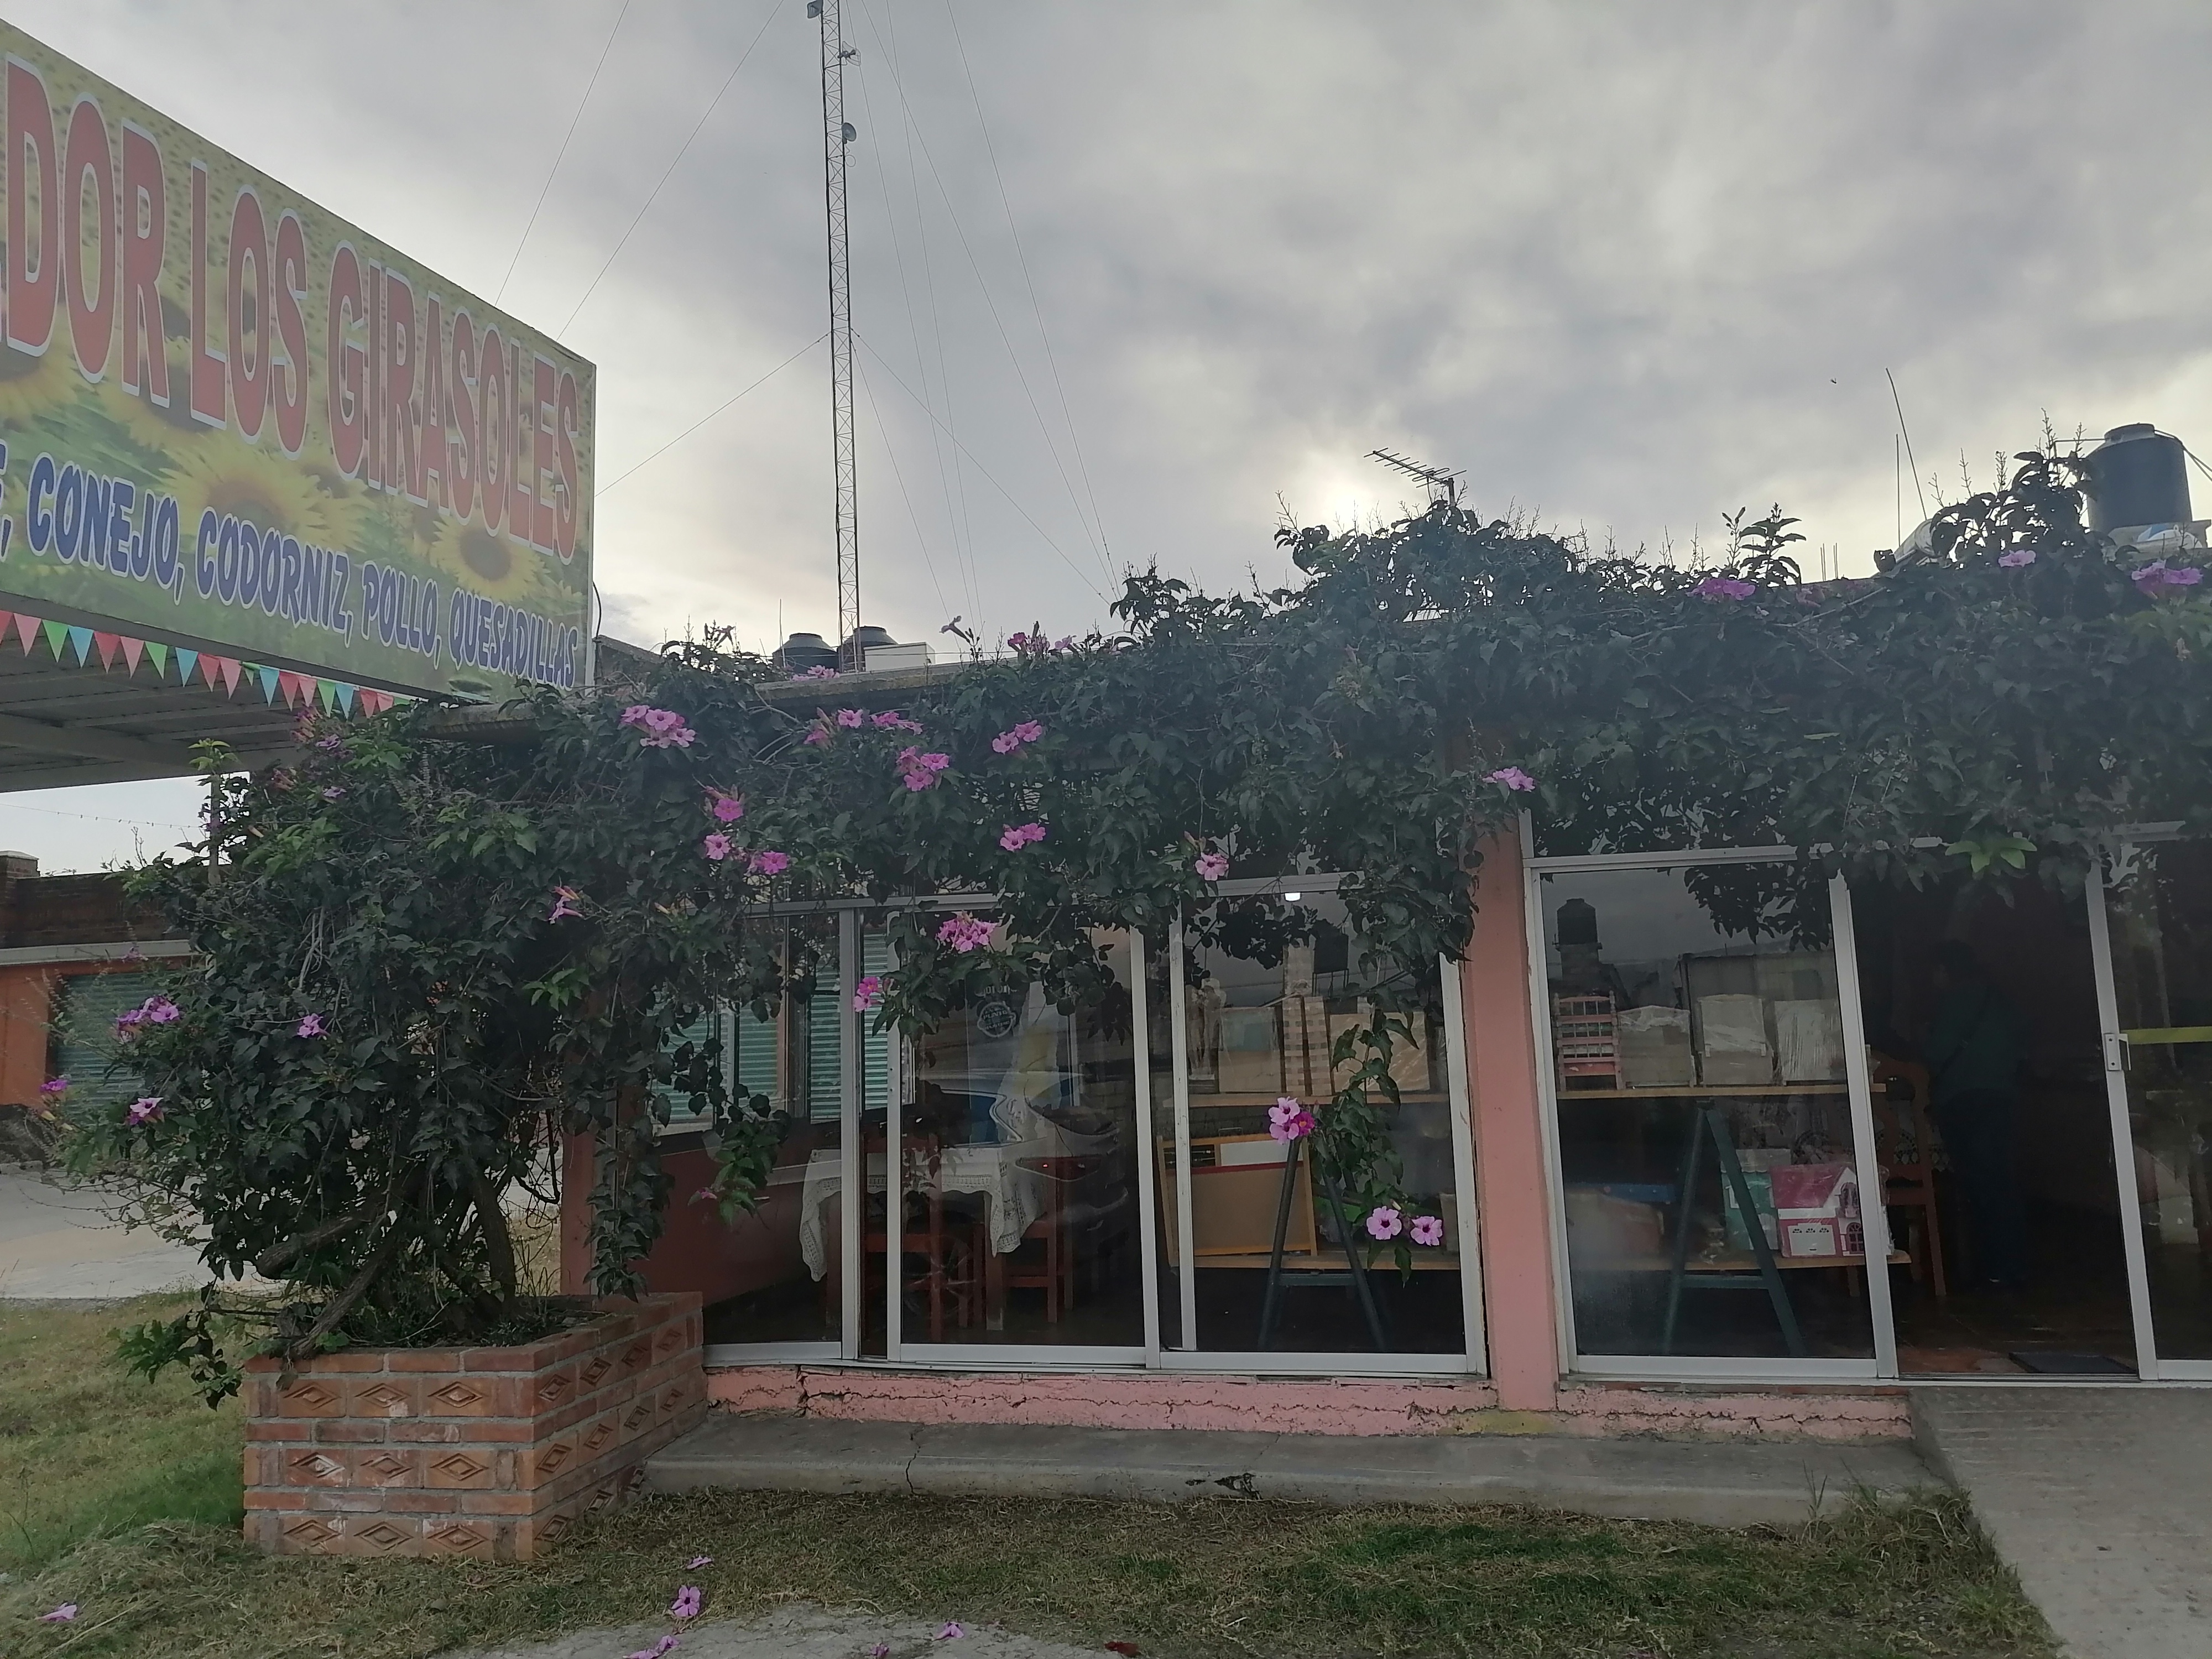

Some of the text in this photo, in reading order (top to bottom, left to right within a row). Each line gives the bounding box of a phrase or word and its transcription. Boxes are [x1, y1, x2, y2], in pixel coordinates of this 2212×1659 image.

[190, 157, 309, 460] LOS
[327, 239, 579, 566] GIRASOLES
[27, 452, 185, 606] CONEJO,
[195, 506, 354, 648] CODORNIZ,
[361, 560, 442, 670] POLLO,
[448, 587, 579, 691] QUESADILLAS
